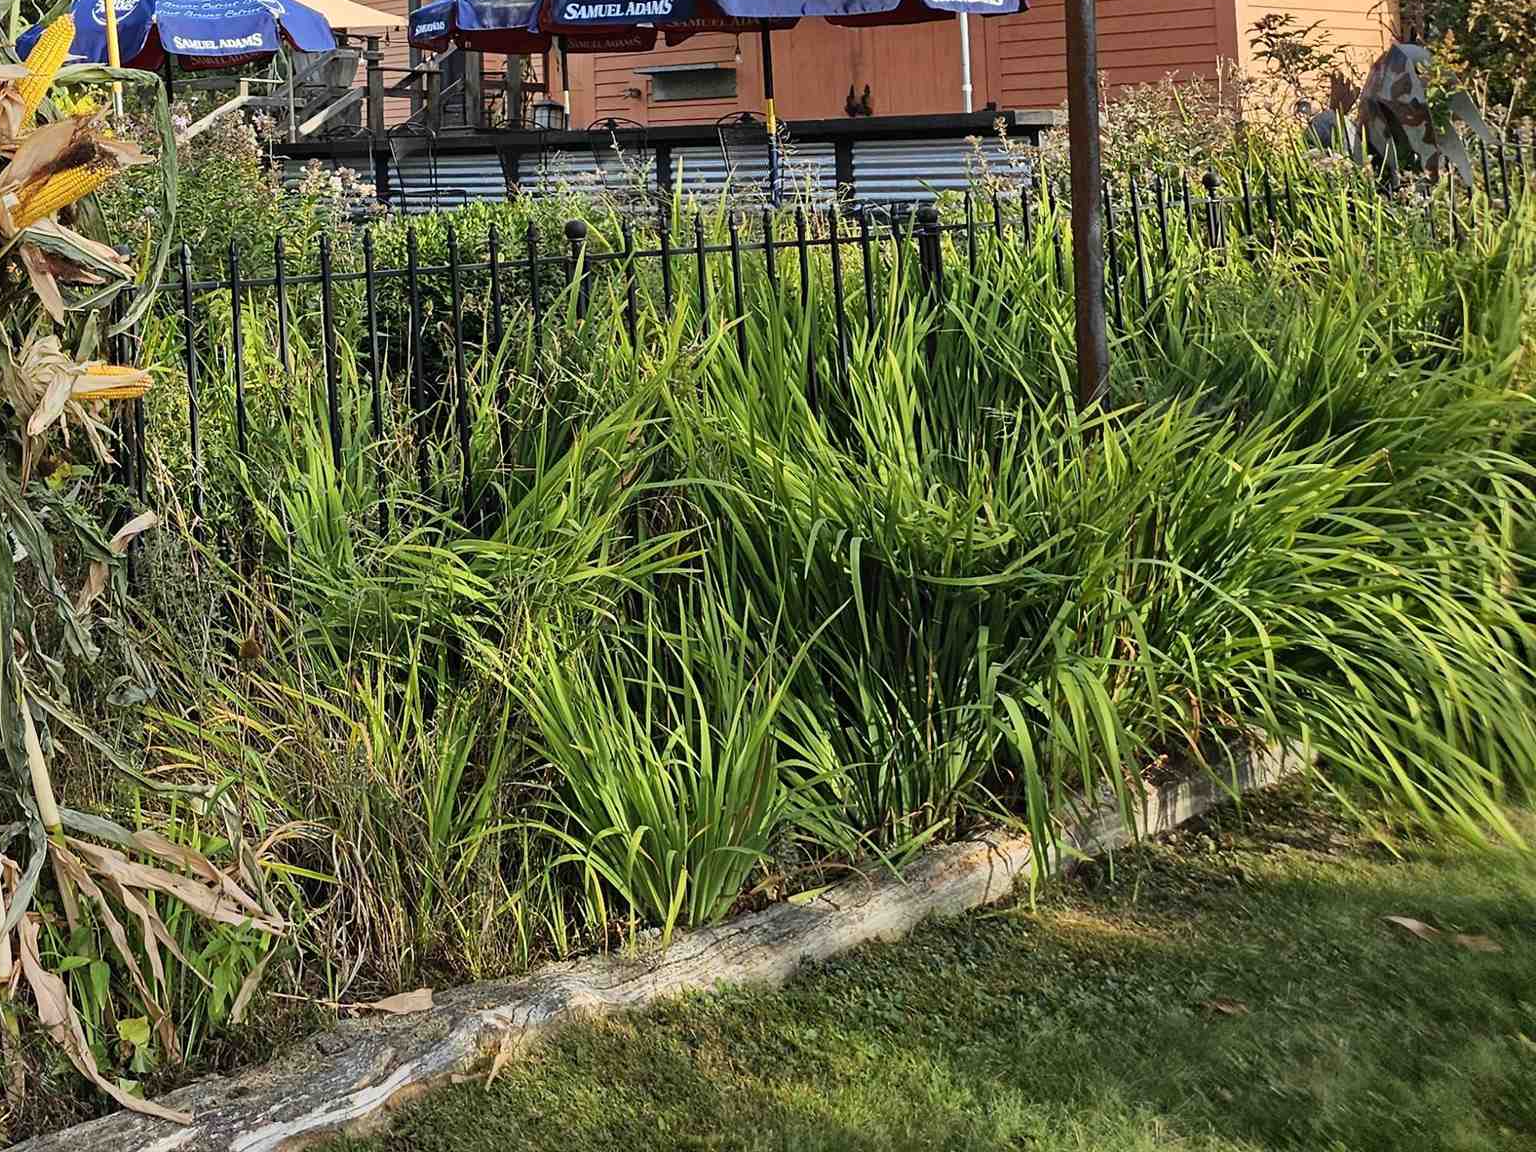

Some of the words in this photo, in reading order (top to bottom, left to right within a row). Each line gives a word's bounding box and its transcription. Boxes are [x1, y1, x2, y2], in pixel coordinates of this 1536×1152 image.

[564, 4, 624, 19] SAMUEL
[173, 36, 218, 49] SAMUEL
[218, 33, 264, 48] ADAMS
